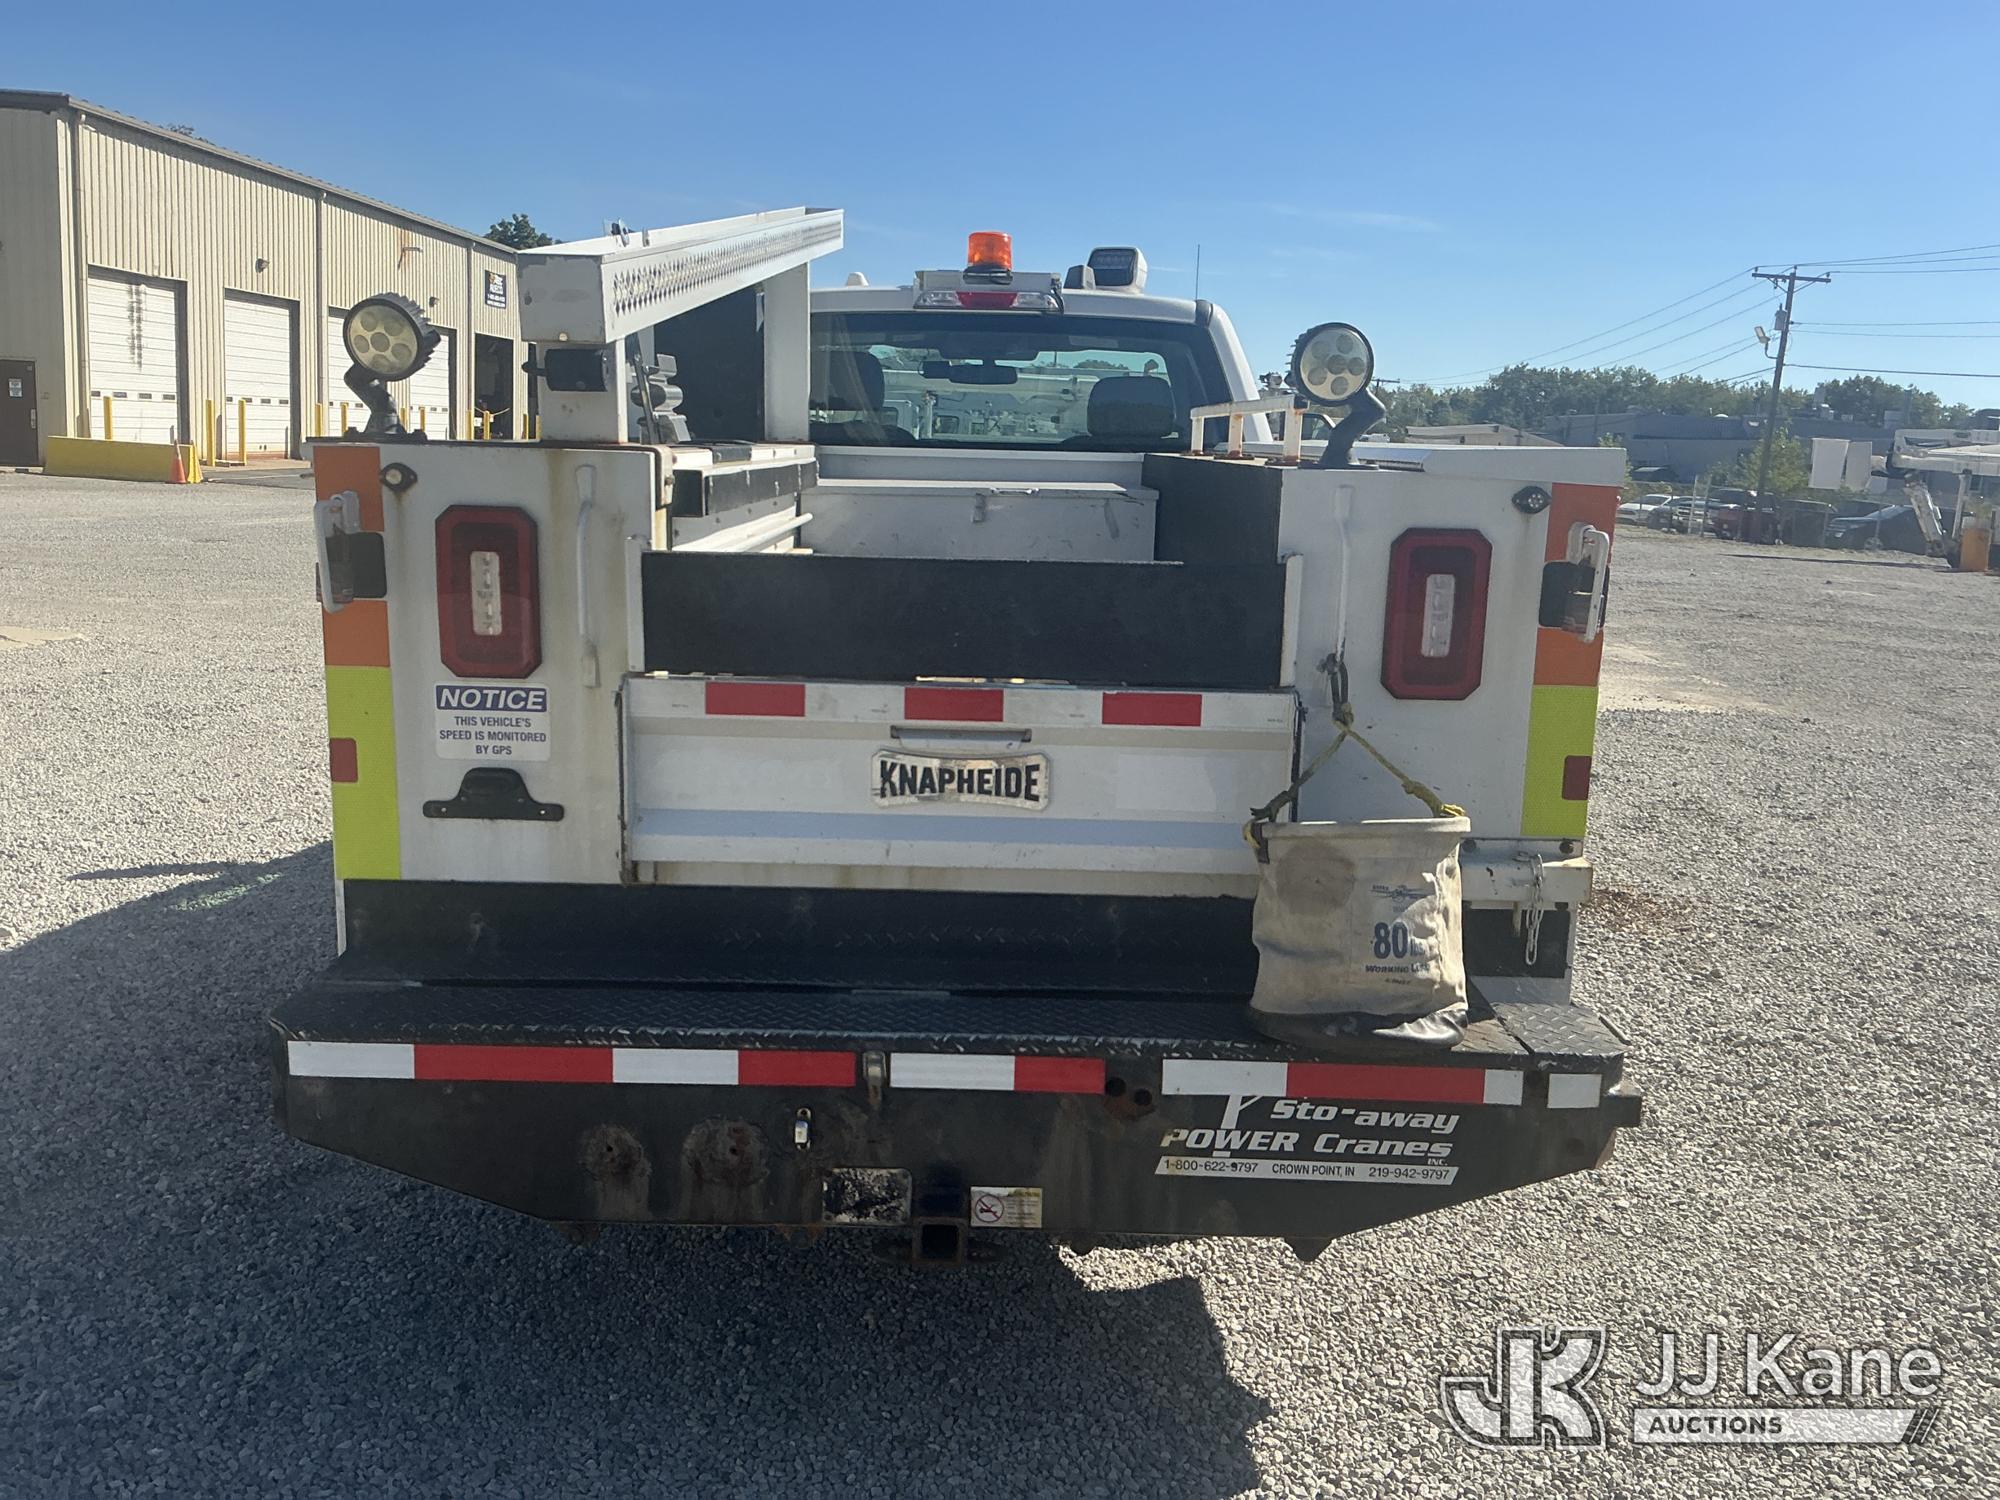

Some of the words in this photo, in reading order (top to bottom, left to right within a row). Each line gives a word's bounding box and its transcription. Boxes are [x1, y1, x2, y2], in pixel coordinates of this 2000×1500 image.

[440, 688, 545, 710] NOTICE
[455, 716, 477, 726] THIS
[480, 716, 531, 728] VEHICLE'S
[439, 730, 471, 740] SPEED
[475, 731, 485, 740] IS
[488, 731, 546, 742] MONITORED
[476, 745, 489, 754] BY
[492, 745, 512, 755] GPS
[880, 759, 1040, 801] KNAPHEIDE
[1374, 921, 1408, 959] 80
[1270, 1099, 1460, 1135] Sto-away
[1160, 1128, 1300, 1152] POWER
[1313, 1133, 1453, 1158] Cranes
[1164, 1159, 1258, 1173] 1-800-622-9797
[1272, 1163, 1309, 1175] CROWN
[1312, 1165, 1342, 1177] POINT,
[1345, 1167, 1355, 1176] IN
[1369, 1167, 1450, 1180] 219-942-9797
[1427, 1158, 1448, 1166] INC.
